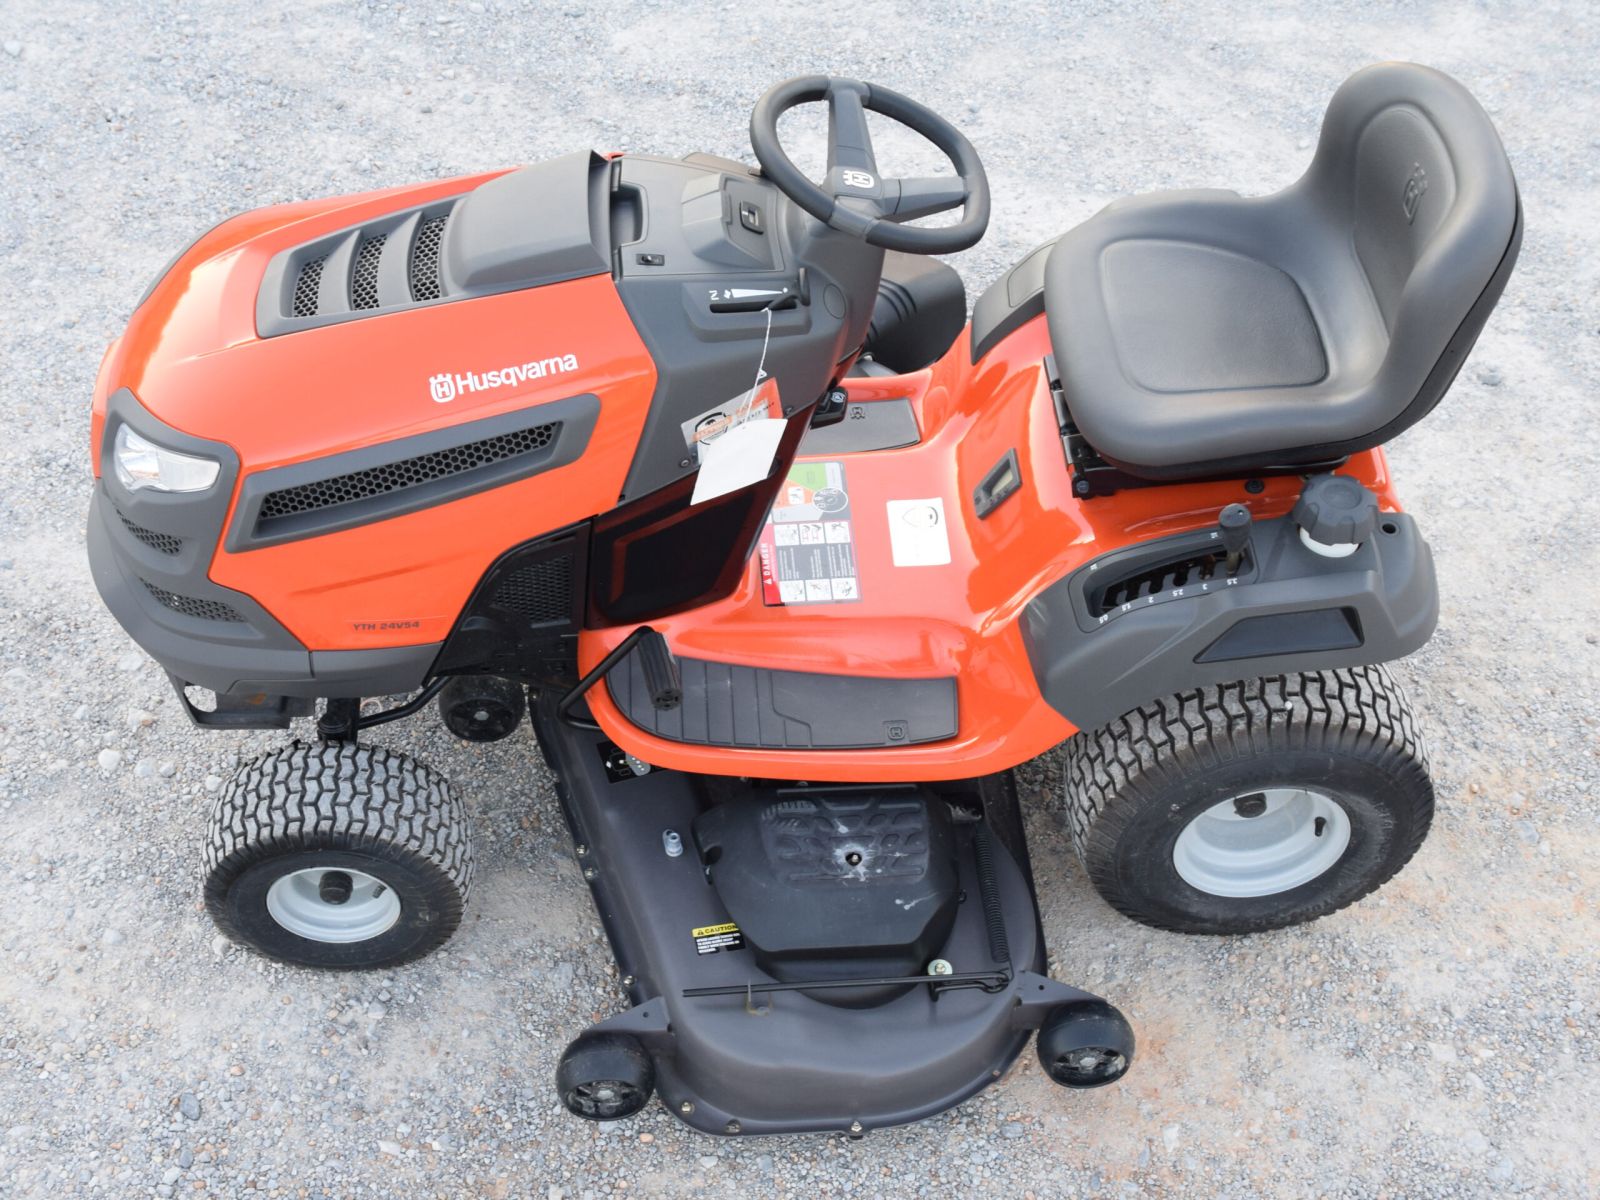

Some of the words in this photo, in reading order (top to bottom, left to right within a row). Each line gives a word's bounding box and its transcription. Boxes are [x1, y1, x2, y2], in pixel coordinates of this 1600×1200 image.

[455, 353, 578, 394] Husqvarna
[761, 543, 770, 576] DANGER
[1172, 588, 1184, 597] 2.5
[353, 623, 376, 631] YTH
[380, 621, 420, 630] 24V54
[704, 925, 736, 934] CAUTION
